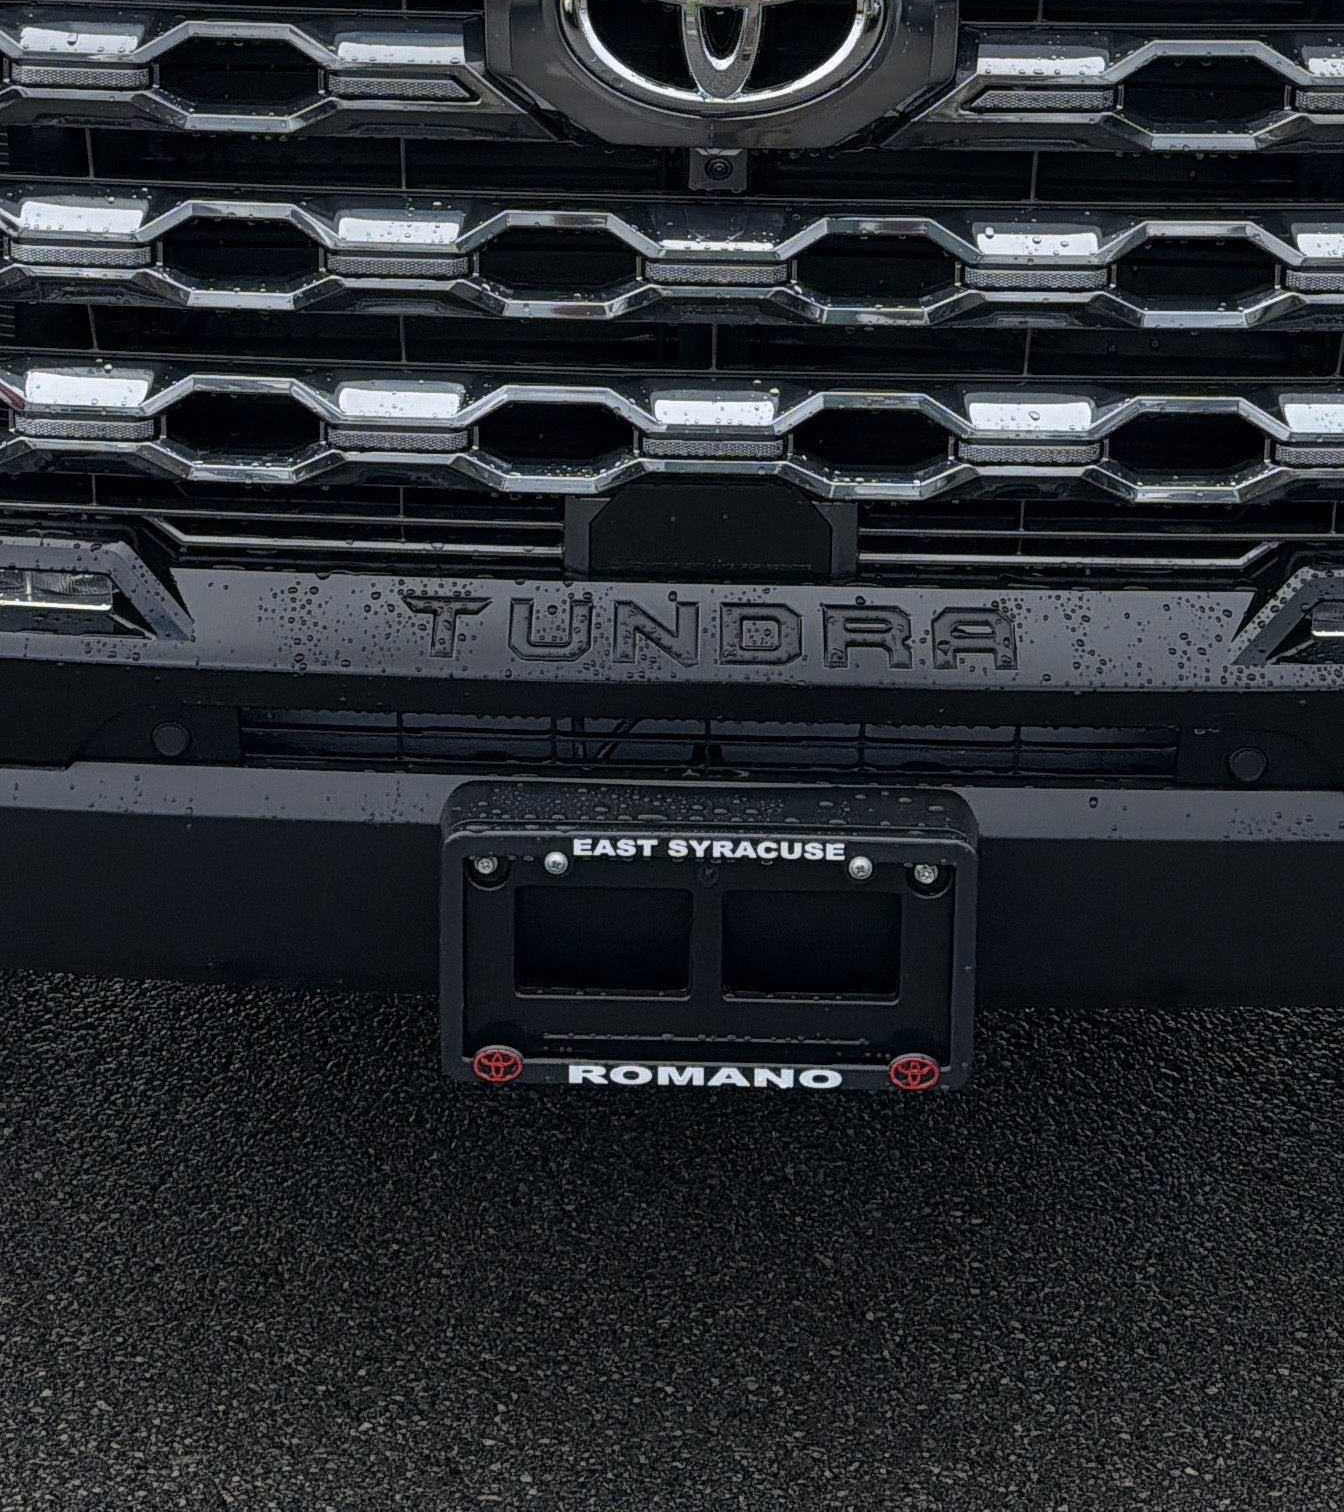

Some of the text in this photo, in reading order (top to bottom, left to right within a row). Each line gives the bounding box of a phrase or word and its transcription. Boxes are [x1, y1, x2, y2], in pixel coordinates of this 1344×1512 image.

[400, 595, 1020, 671] TUNDRA
[573, 838, 846, 861] EAST SYRACUSE
[568, 1064, 843, 1089] ROMANO
